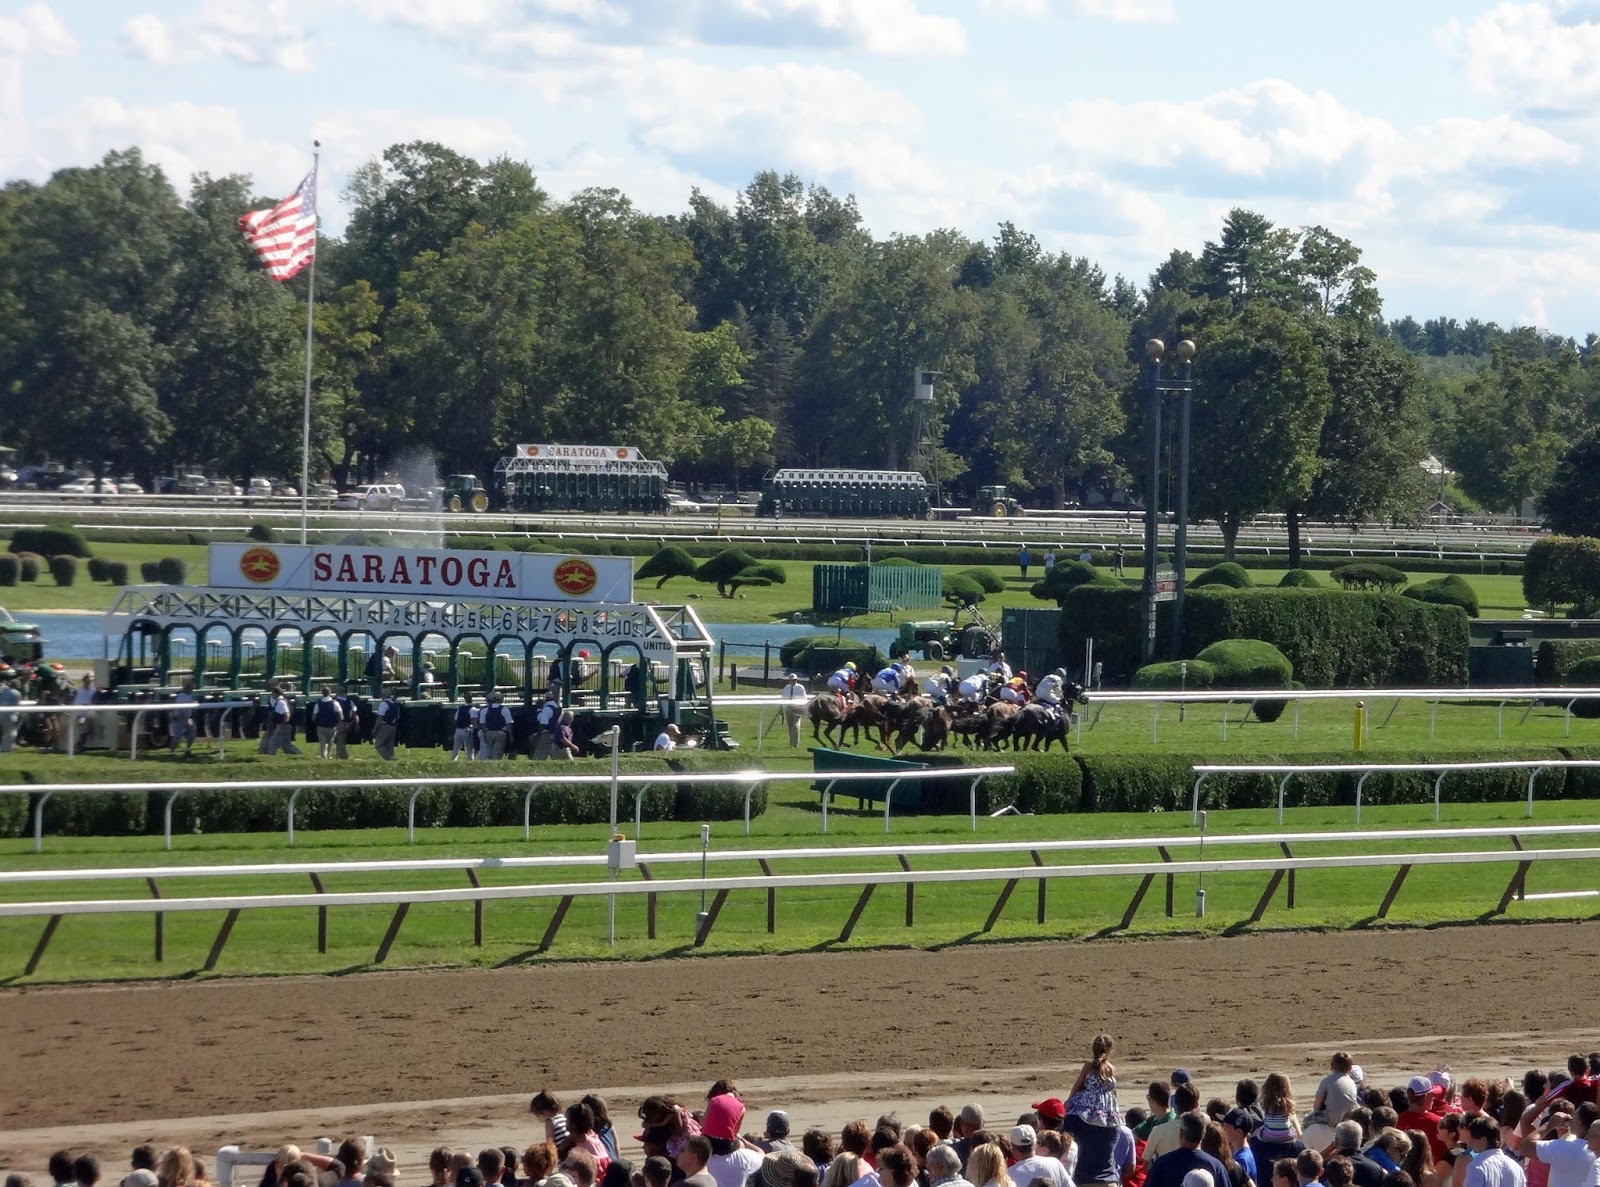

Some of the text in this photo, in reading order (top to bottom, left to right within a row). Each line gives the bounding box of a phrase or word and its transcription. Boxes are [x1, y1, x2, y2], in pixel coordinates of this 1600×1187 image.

[313, 552, 517, 589] SARATOGA
[357, 607, 363, 622] 1
[393, 608, 400, 624] 2
[430, 610, 437, 626] 4
[467, 612, 476, 628] 5
[502, 612, 513, 630] 6
[542, 615, 552, 631] 7
[581, 617, 588, 633] 8
[617, 619, 631, 635] 10
[643, 641, 672, 651] UNITED
